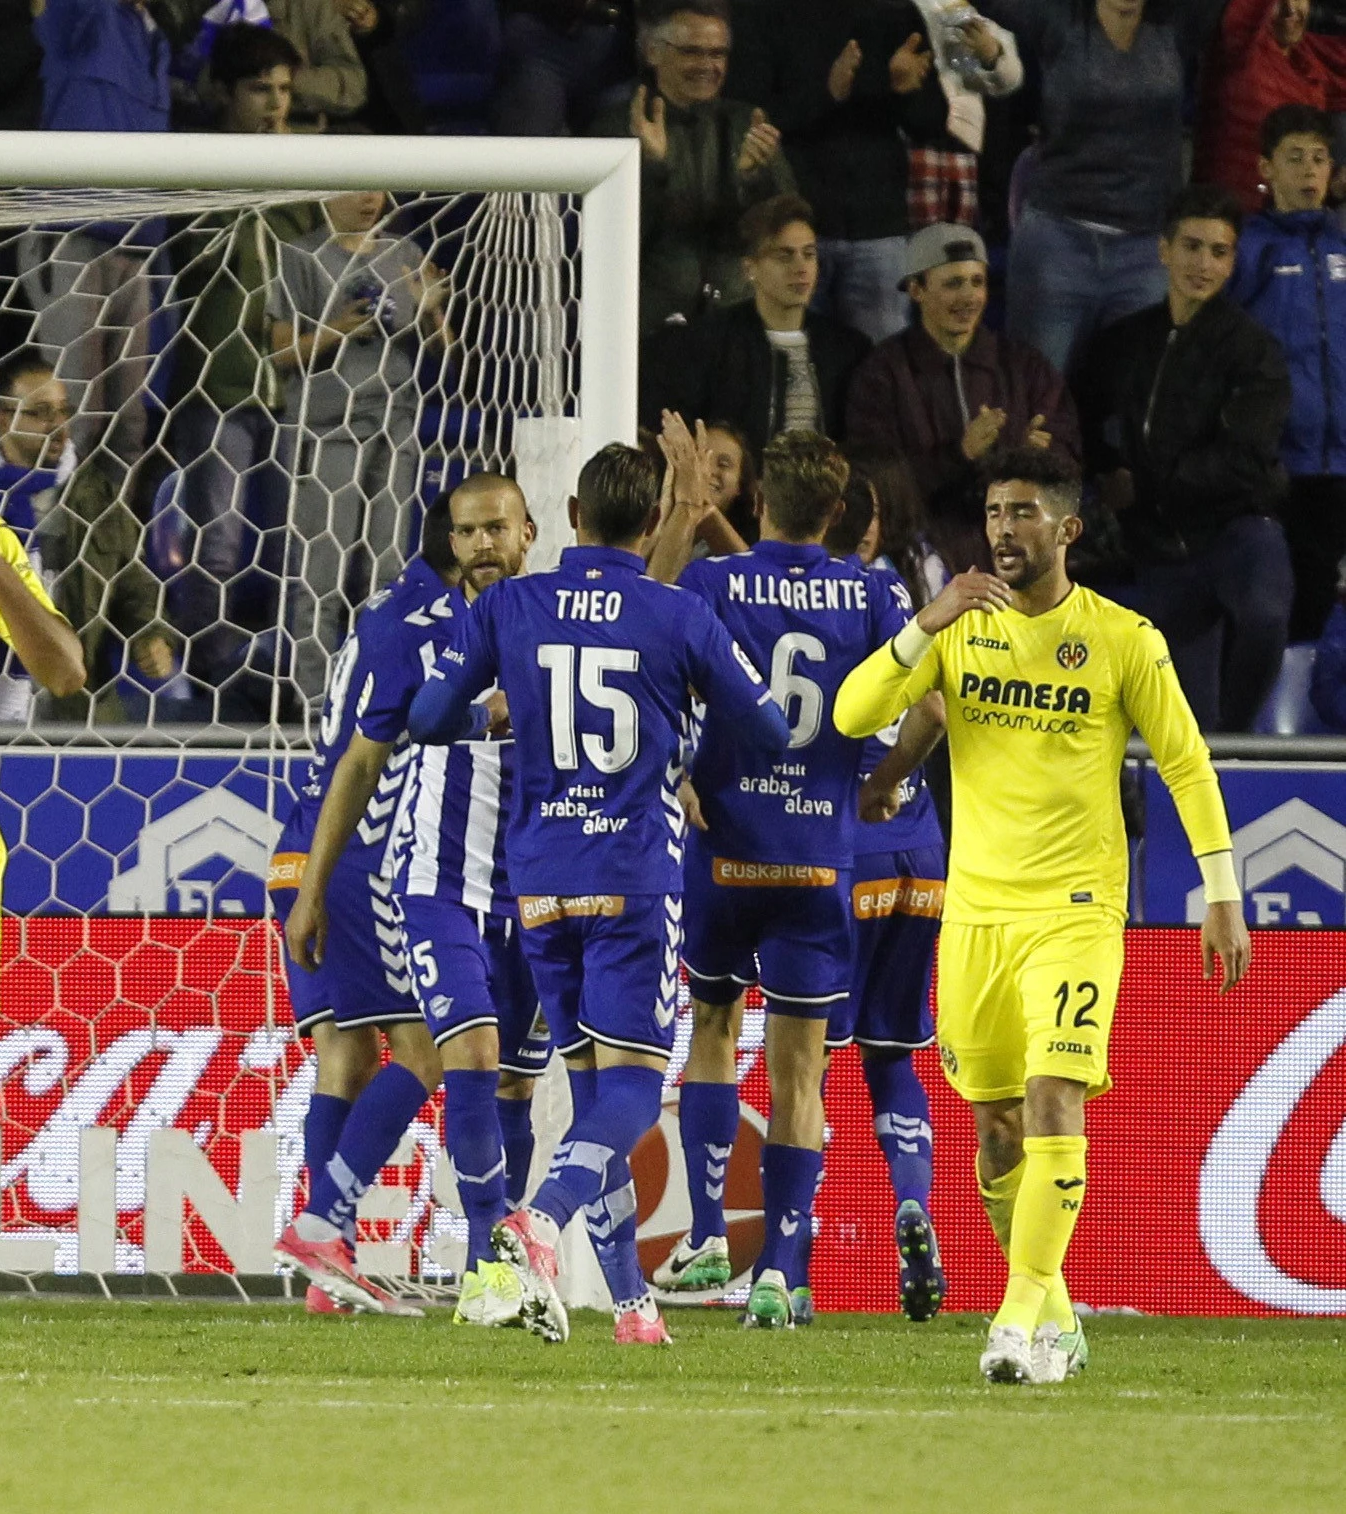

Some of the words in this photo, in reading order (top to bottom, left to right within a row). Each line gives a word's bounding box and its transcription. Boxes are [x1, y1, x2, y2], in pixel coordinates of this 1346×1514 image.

[555, 589, 623, 622] THEO
[728, 573, 868, 611] M.LLORENTE
[537, 643, 640, 774] 15
[770, 631, 827, 749] 6
[960, 671, 1091, 714] PAMESA
[739, 775, 791, 796] araba
[772, 762, 807, 777] visit
[1054, 980, 1100, 1030] 12
